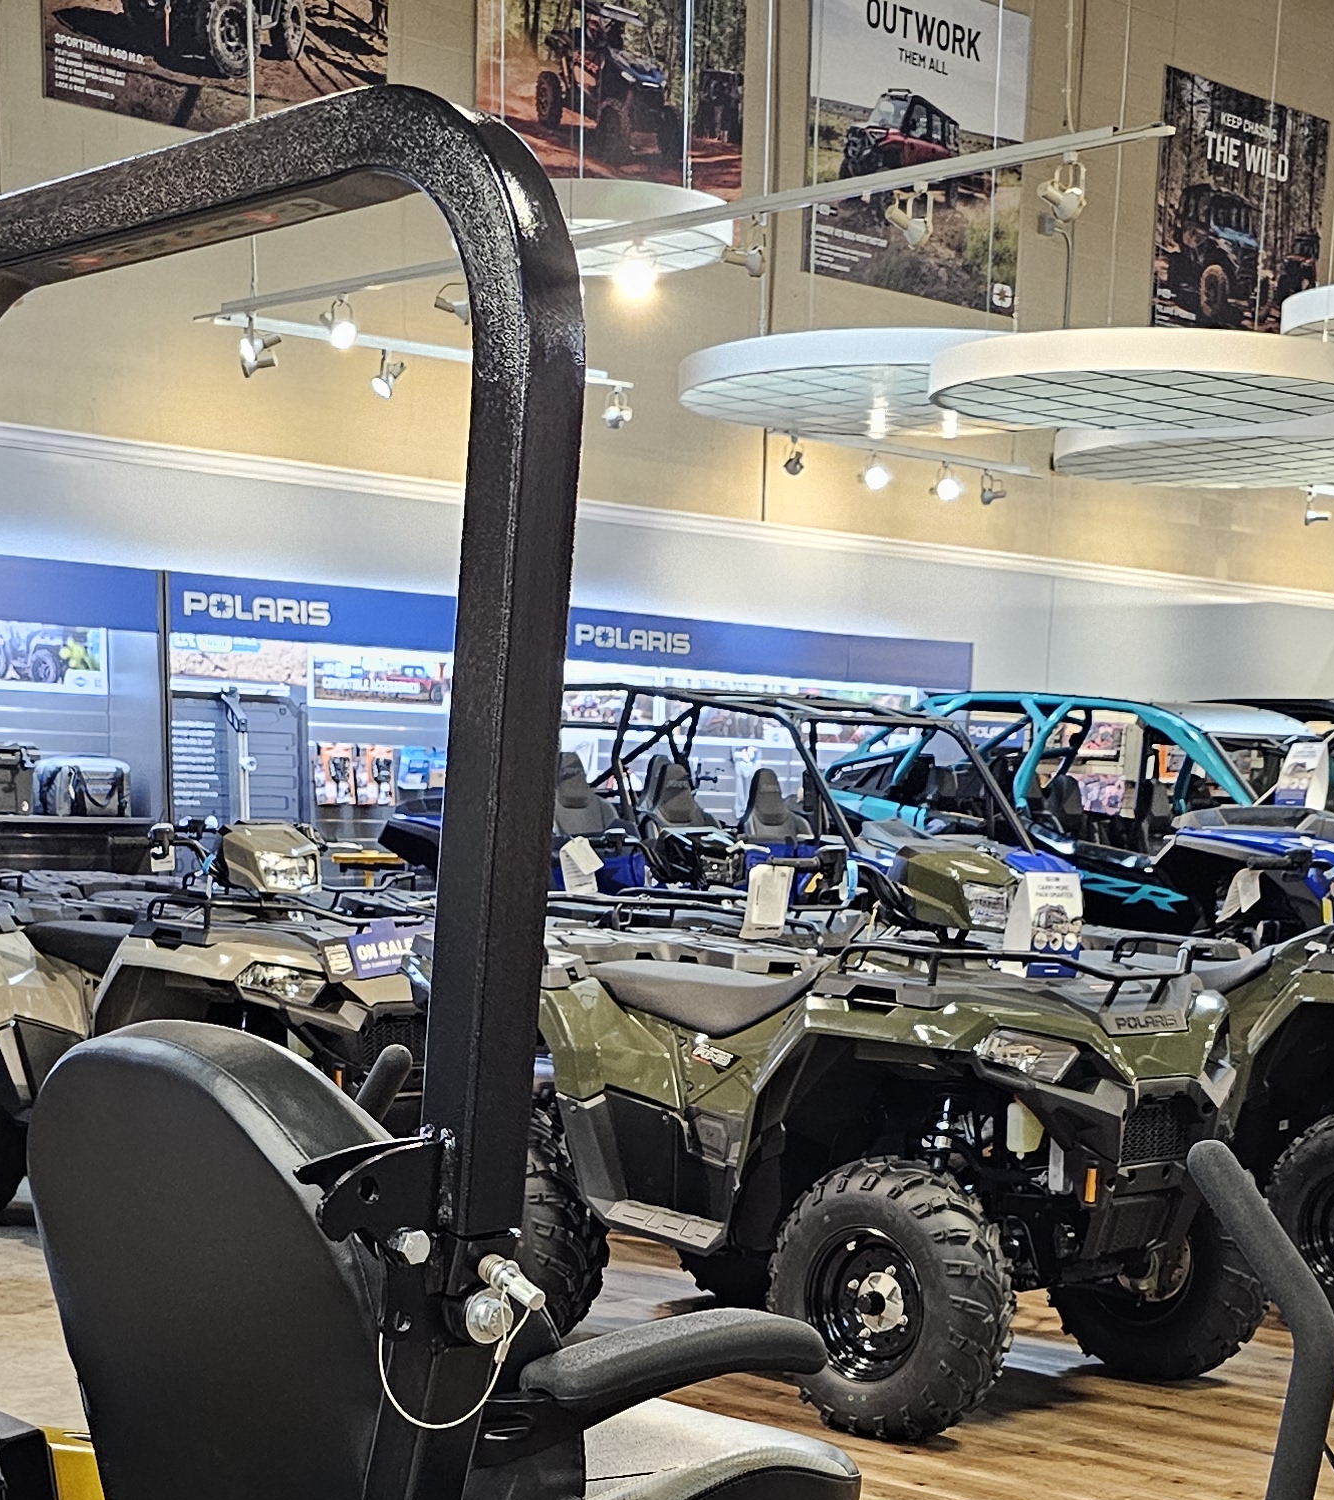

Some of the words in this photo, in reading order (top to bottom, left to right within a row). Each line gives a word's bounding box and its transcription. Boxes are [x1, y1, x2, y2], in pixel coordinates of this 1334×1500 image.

[54, 33, 110, 57] SPORTSMAN
[867, 0, 981, 62] OUTWORK
[898, 47, 926, 69] THEM
[928, 57, 948, 76] ALL
[1220, 112, 1243, 129] KEEP
[1205, 130, 1241, 168] THE
[1245, 142, 1289, 182] WILD
[183, 590, 332, 627] POLARIS
[575, 623, 691, 655] POLARIS
[1078, 869, 1189, 913] ZR
[356, 943, 379, 962] ON
[1115, 1014, 1177, 1031] POLARIS
